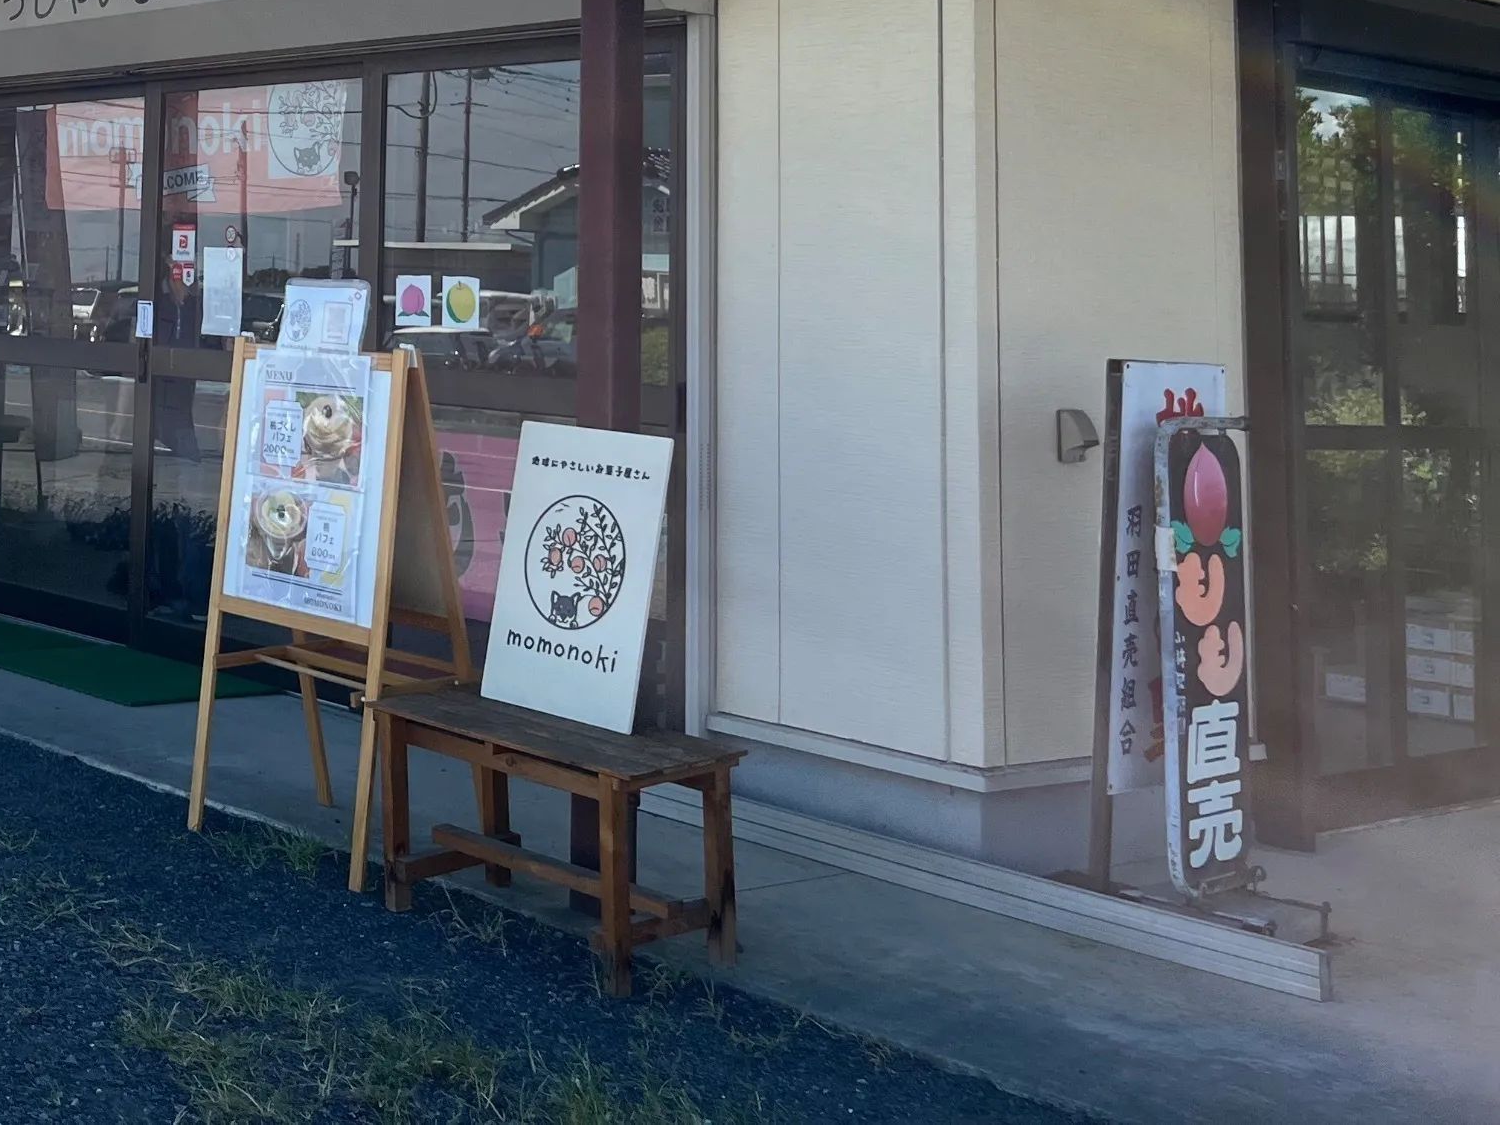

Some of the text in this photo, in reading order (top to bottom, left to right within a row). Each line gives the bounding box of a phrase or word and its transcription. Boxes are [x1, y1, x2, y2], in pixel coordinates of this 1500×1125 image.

[57, 100, 263, 158] momnoki
[164, 169, 205, 190] COME
[265, 369, 293, 381] MENU
[506, 629, 618, 673] momonoki
[1119, 505, 1142, 756] 羽田直売組合
